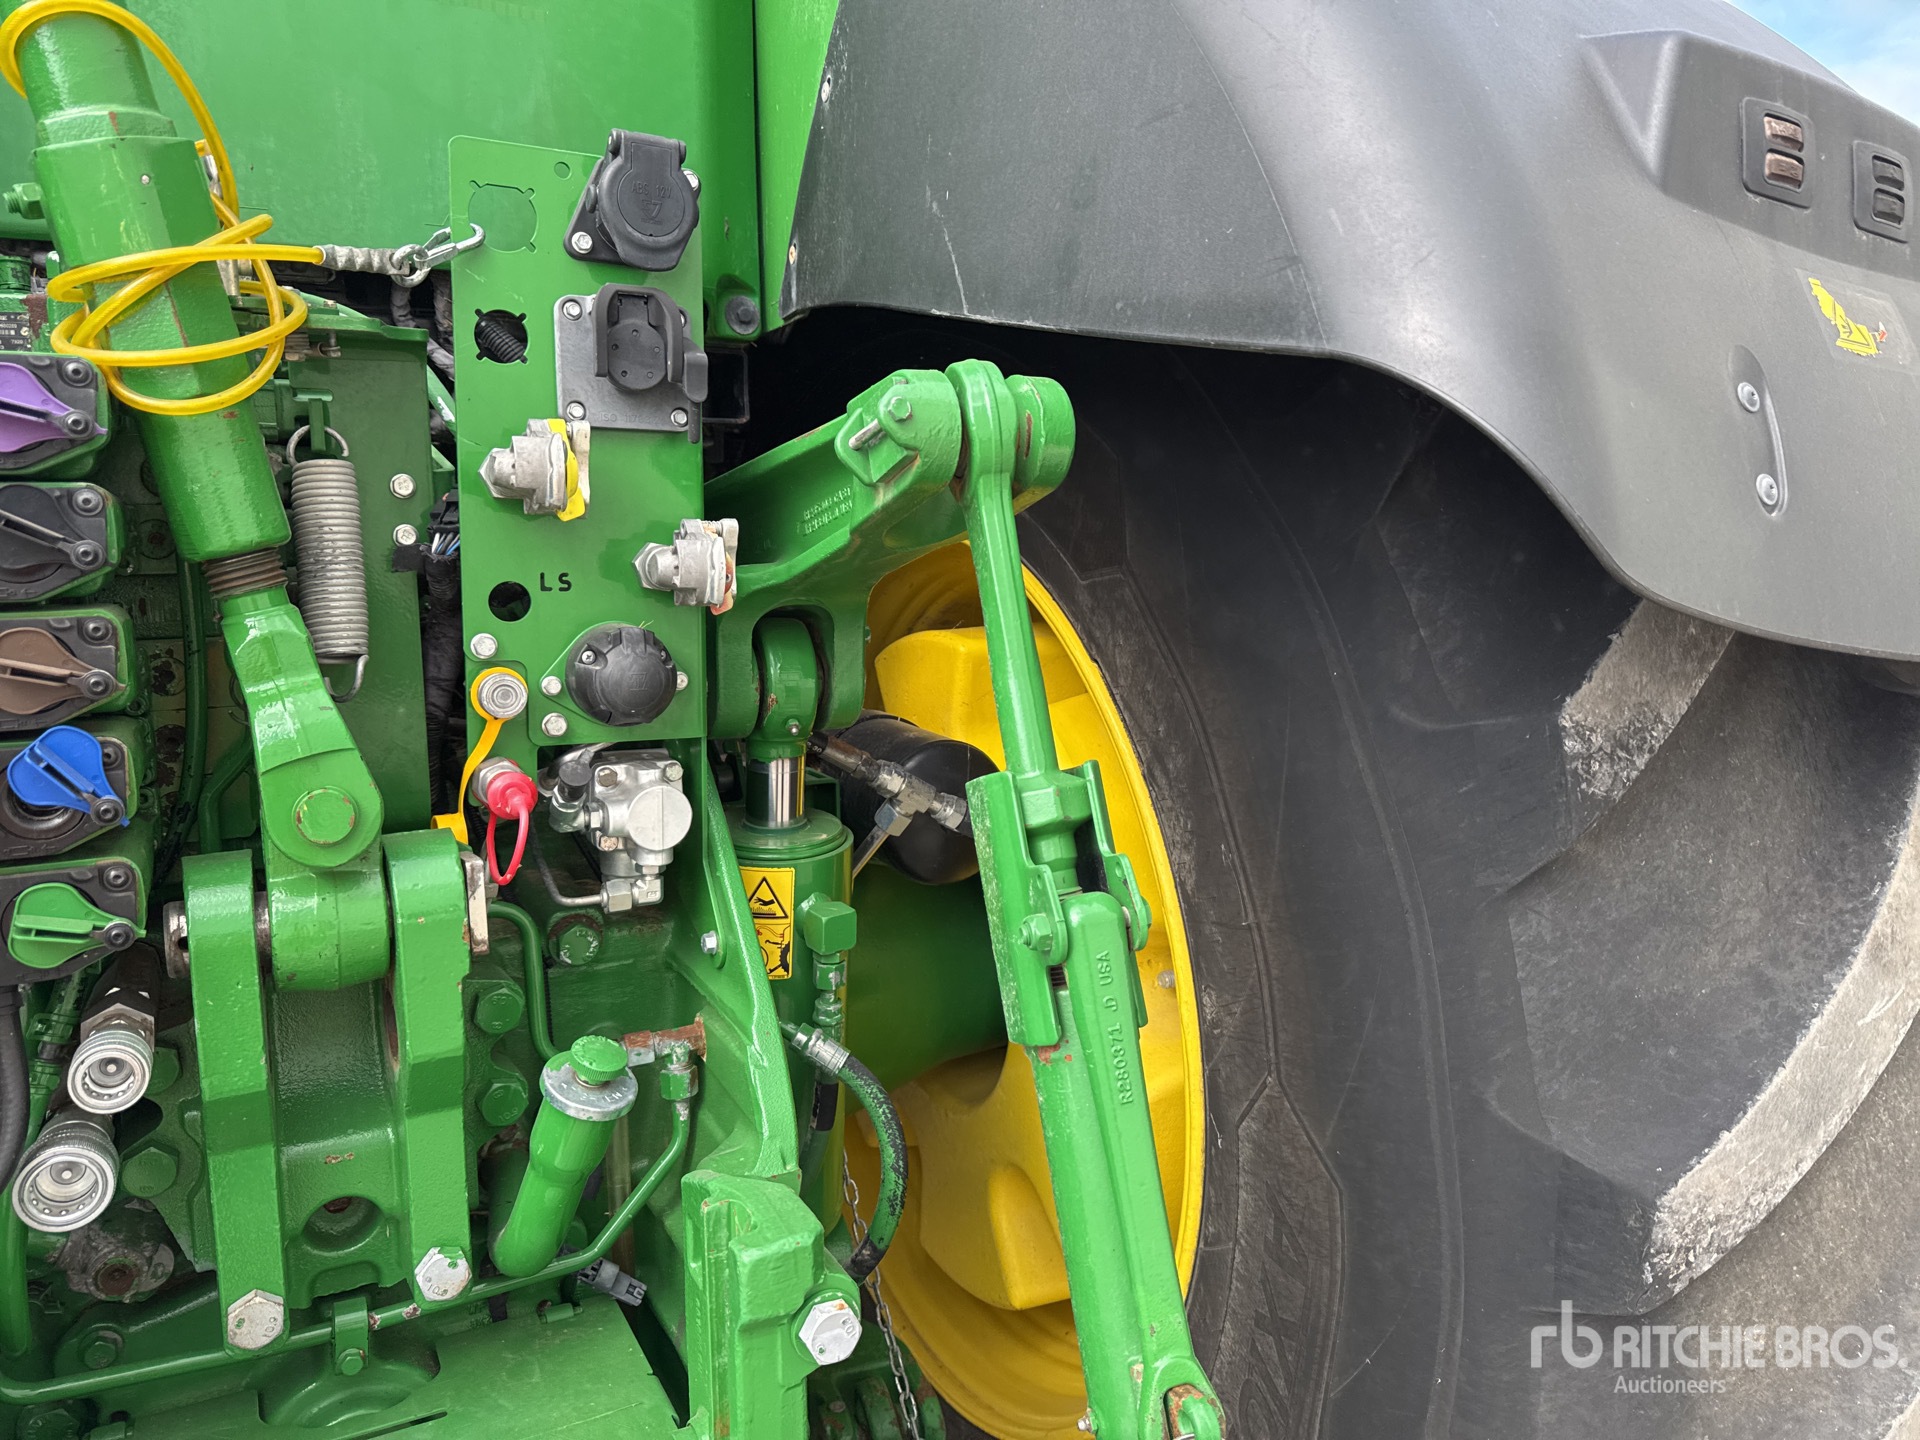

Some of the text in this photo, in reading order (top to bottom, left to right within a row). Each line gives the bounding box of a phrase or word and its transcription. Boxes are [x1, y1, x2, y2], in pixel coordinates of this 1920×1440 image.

[631, 180, 673, 199] ABS 12V
[540, 572, 572, 592] LS
[1096, 950, 1114, 987] USA
